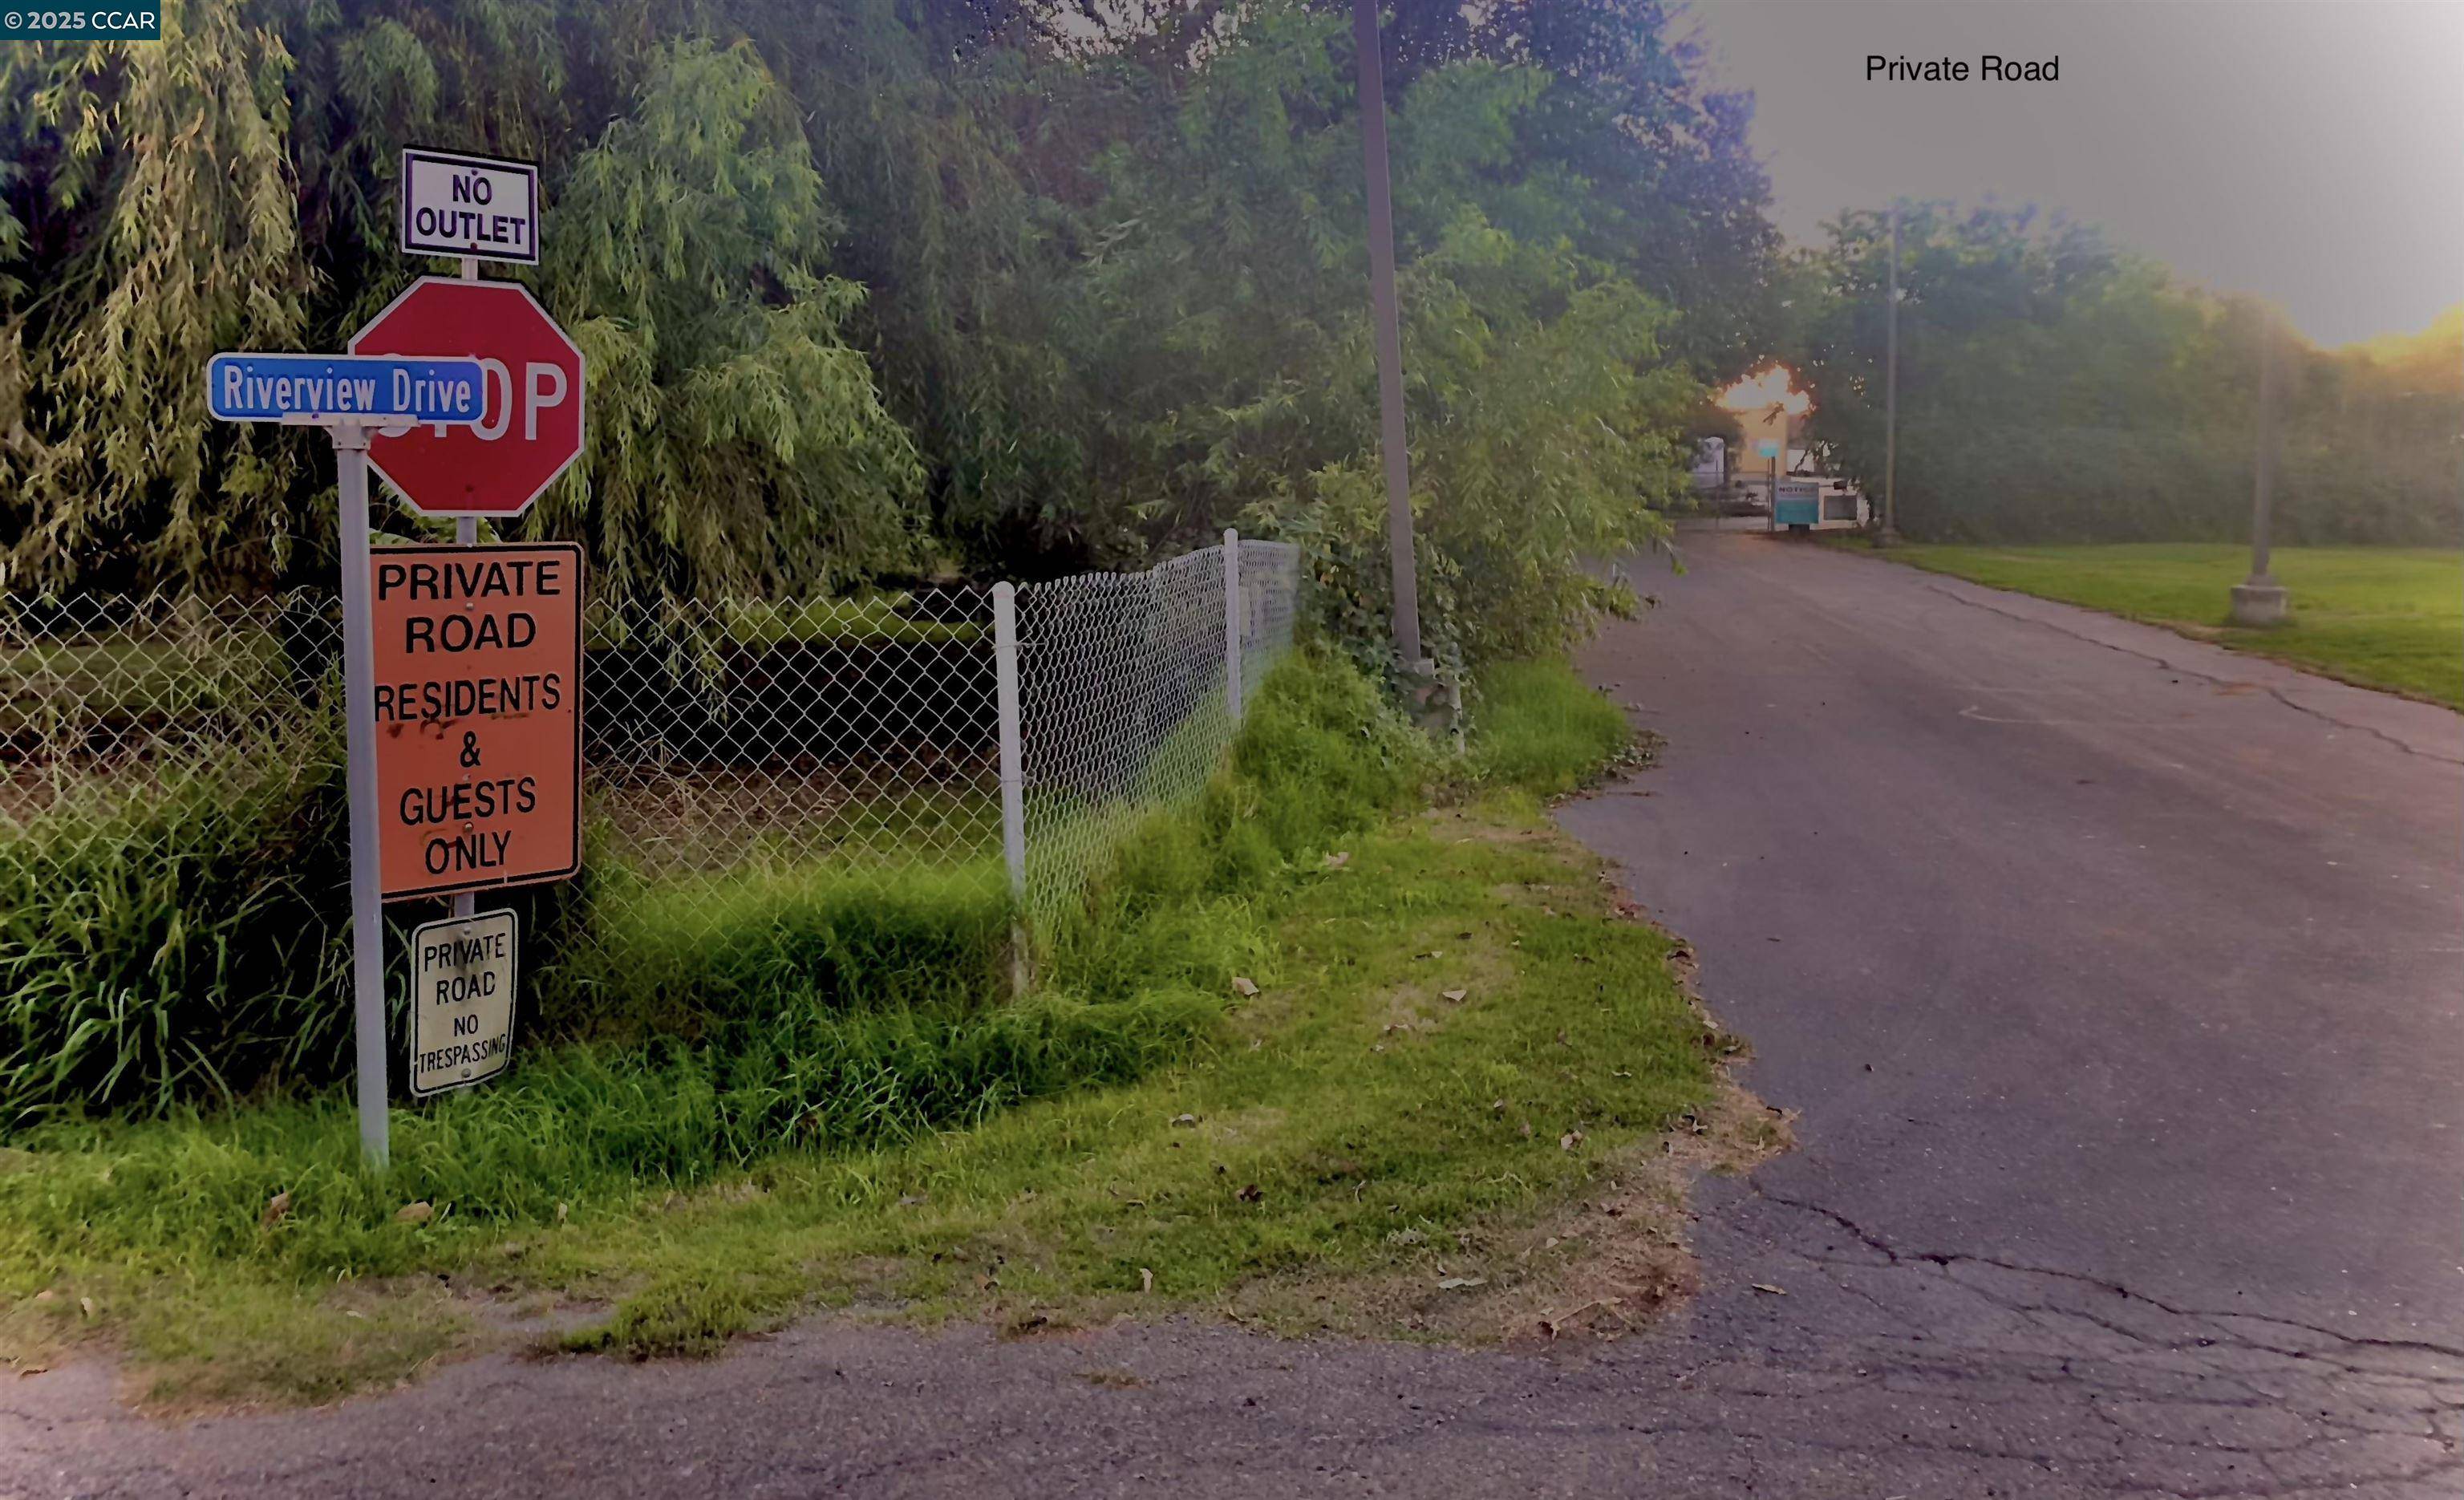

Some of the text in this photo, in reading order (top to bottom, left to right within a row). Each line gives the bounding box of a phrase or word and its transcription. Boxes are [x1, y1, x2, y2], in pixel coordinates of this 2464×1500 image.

[452, 173, 492, 205] NO
[415, 207, 526, 245] OUTLET
[224, 365, 472, 413] Riverview Drive
[377, 355, 568, 441] OP
[378, 560, 561, 601] PRIVATE
[405, 612, 537, 654] ROAD
[375, 673, 561, 722] RESIDENTS
[460, 731, 481, 768] &
[400, 776, 536, 826] GUESTS
[425, 829, 512, 874] ONLY
[424, 933, 506, 972] PRIVATE
[436, 971, 496, 1005] ROAD
[454, 1014, 479, 1037] NO
[419, 1033, 506, 1073] TRESPASSING
